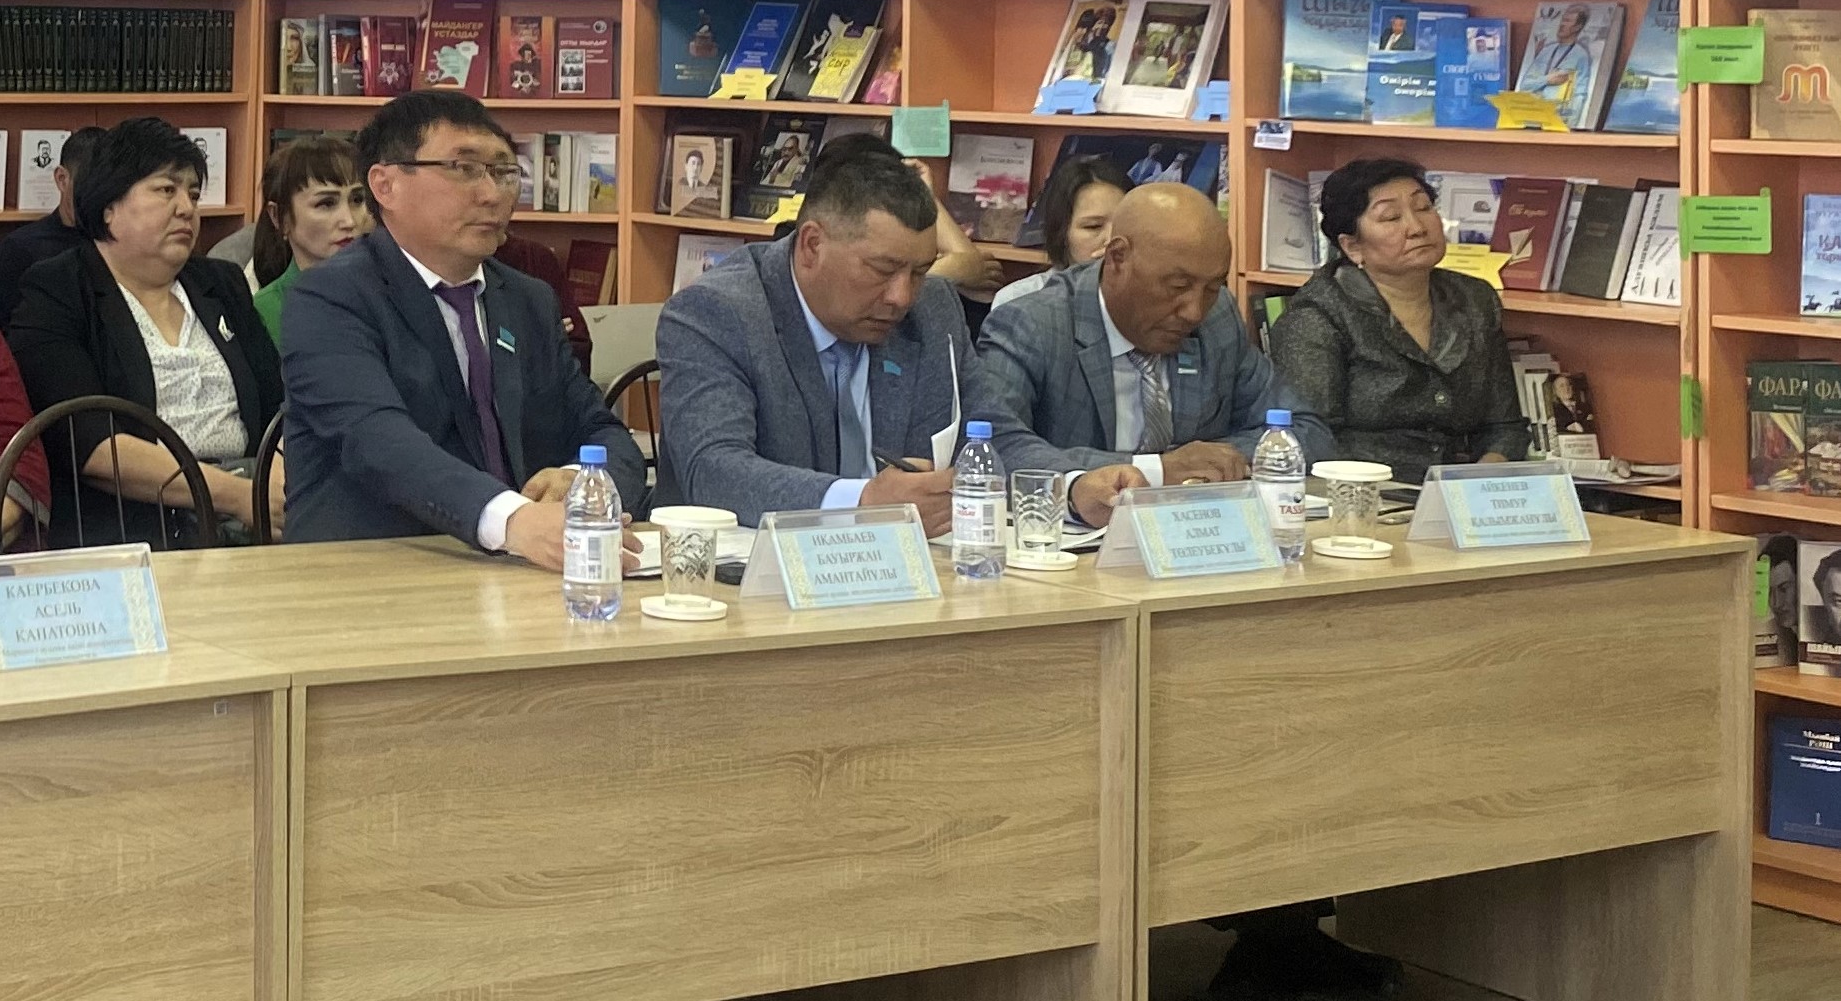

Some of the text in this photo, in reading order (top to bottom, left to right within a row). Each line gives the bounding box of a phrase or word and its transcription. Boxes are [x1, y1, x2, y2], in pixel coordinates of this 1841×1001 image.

[1490, 498, 1528, 510] ТИМУР
[816, 550, 883, 566] БАУЫРЖАН
[34, 601, 82, 619] АСЕЛЬ
[15, 621, 108, 644] КАНАТОВНА
